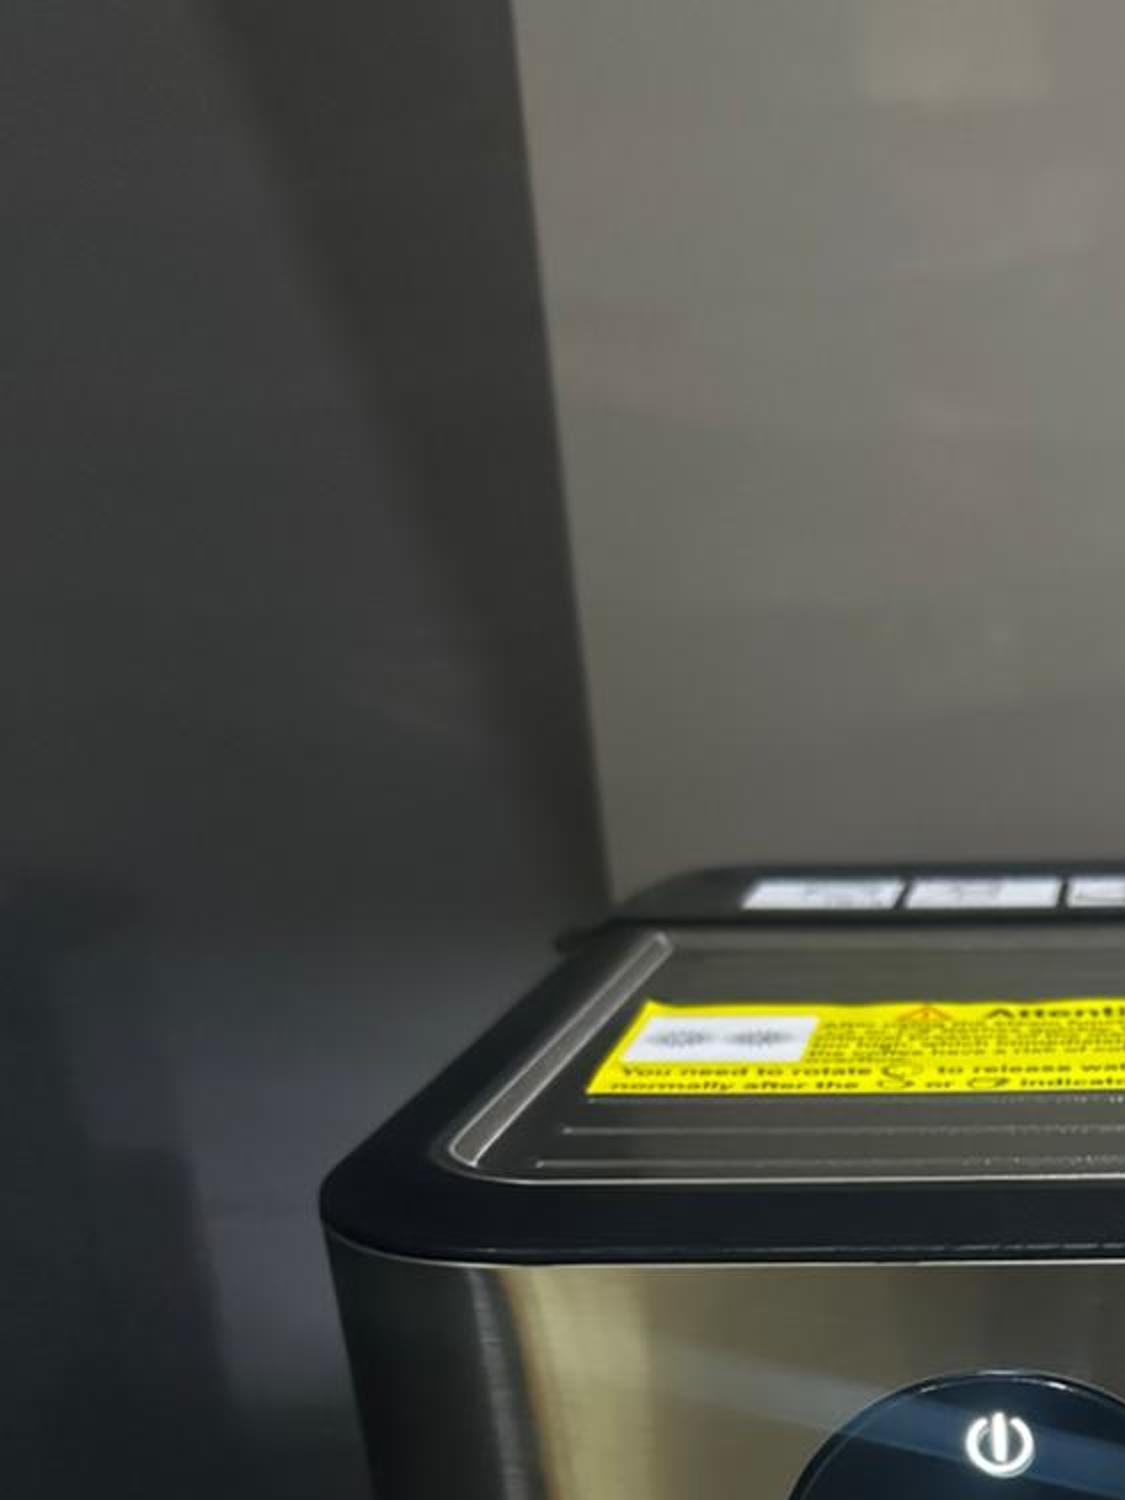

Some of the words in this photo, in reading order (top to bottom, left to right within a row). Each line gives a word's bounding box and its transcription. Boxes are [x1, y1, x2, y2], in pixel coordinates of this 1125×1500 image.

[621, 1067, 672, 1077] You
[680, 1067, 749, 1077] need
[757, 1067, 779, 1076] to
[791, 1066, 872, 1076] rotate
[938, 1065, 964, 1074] to
[973, 1064, 1072, 1074] release
[610, 1081, 734, 1091] normally
[743, 1081, 806, 1090] after
[815, 1081, 859, 1089] the
[926, 1081, 954, 1089] or
